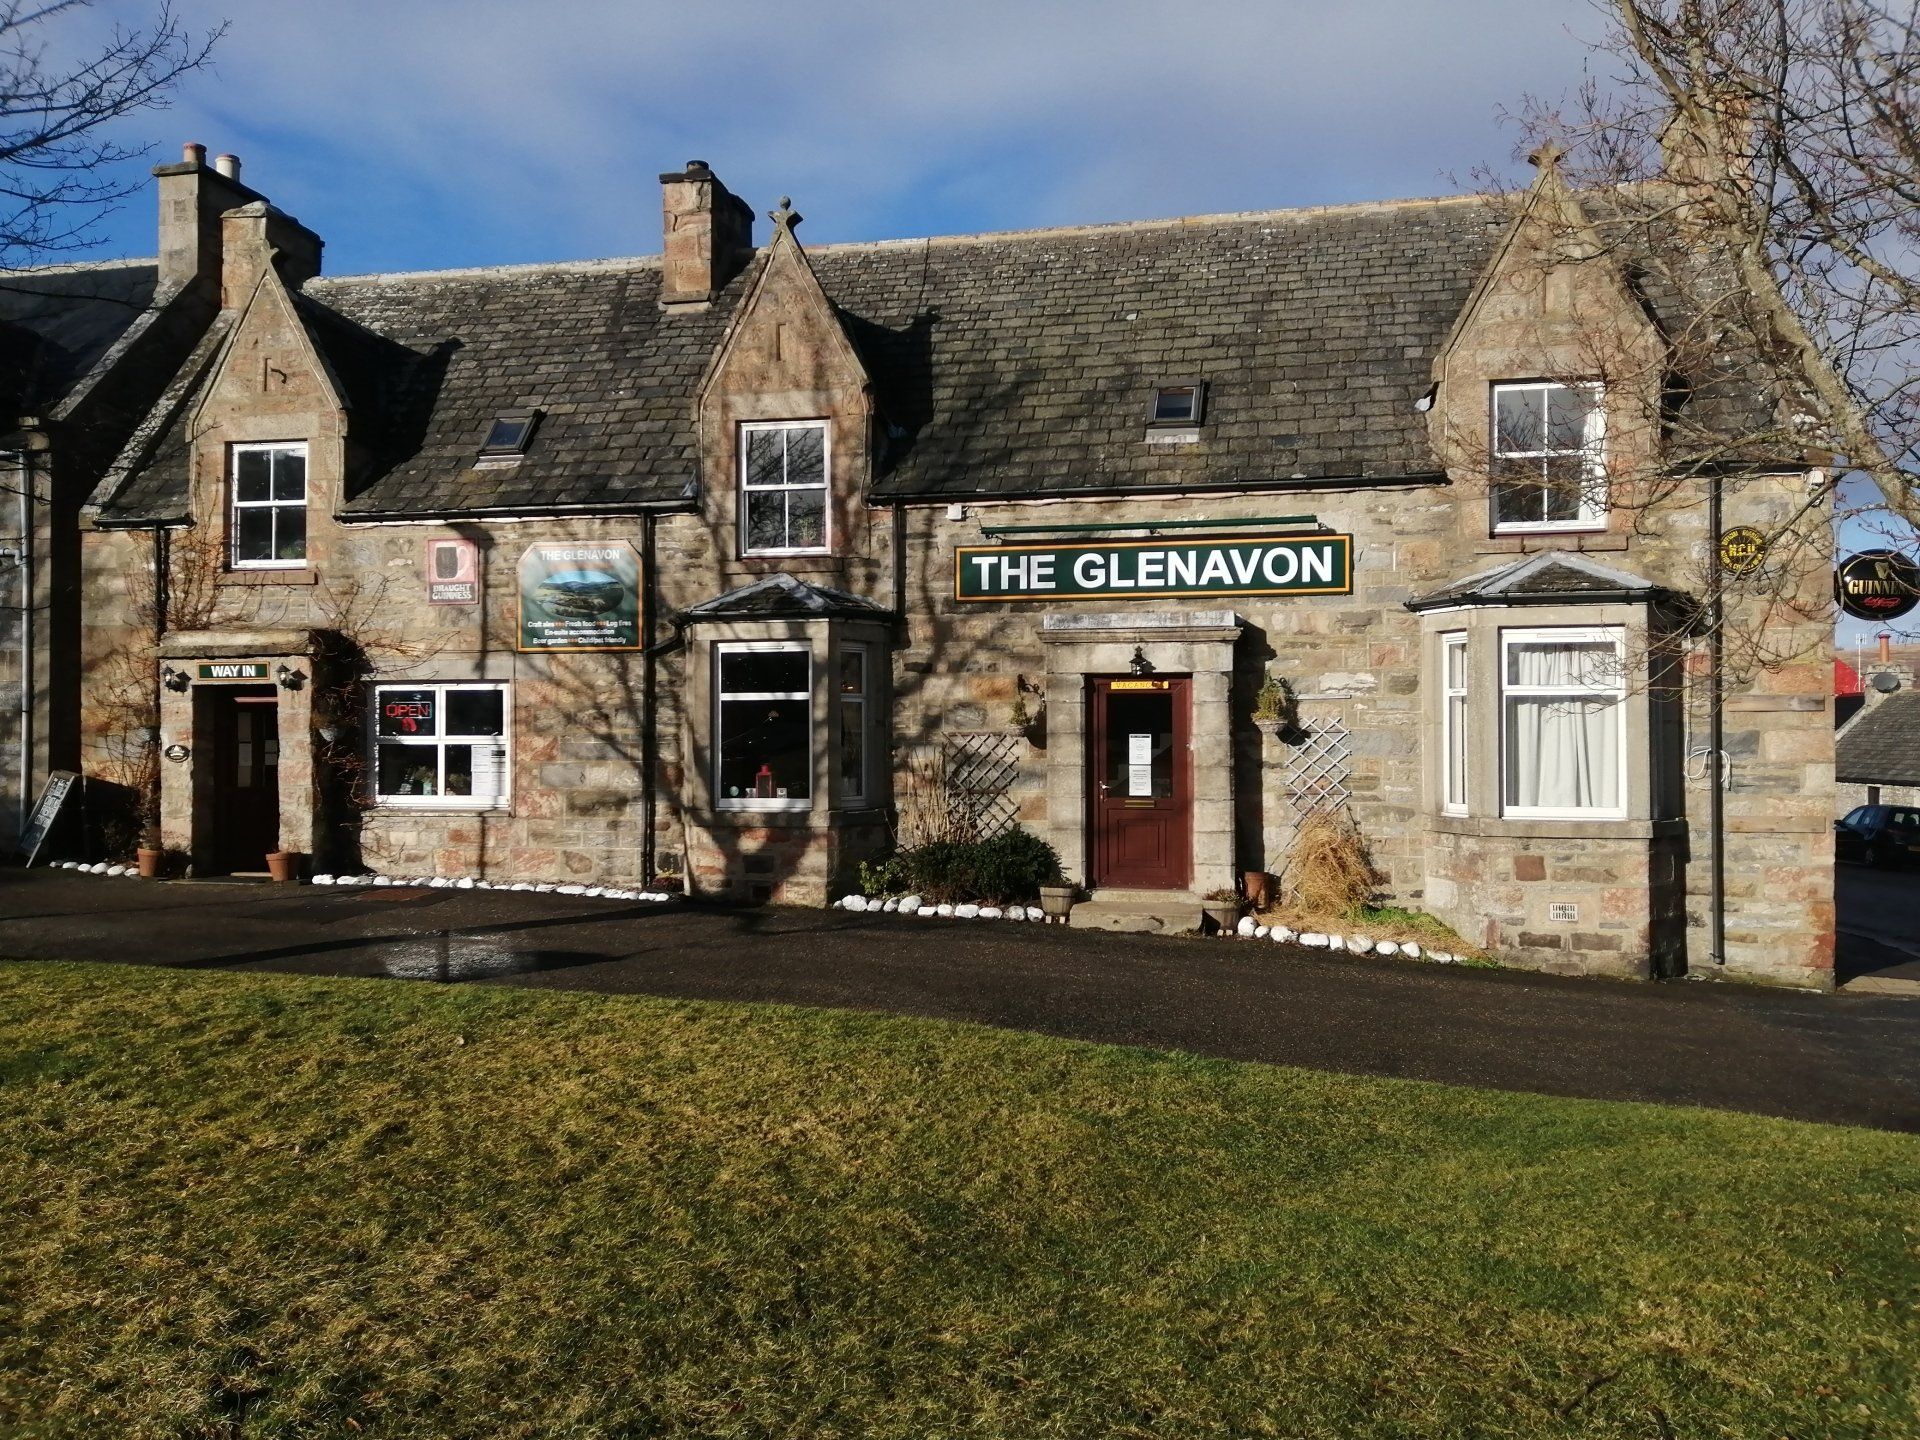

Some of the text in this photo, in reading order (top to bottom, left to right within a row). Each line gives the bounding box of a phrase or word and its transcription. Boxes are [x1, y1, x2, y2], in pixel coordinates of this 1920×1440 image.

[540, 549, 620, 561] THE GLENAVON
[972, 545, 1332, 590] THE GLENAVON
[432, 584, 472, 592] DRAUGHT
[432, 591, 473, 600] GUINNESS
[606, 620, 618, 628] Log
[211, 665, 256, 677] WAY IN
[385, 703, 429, 717] OPEN
